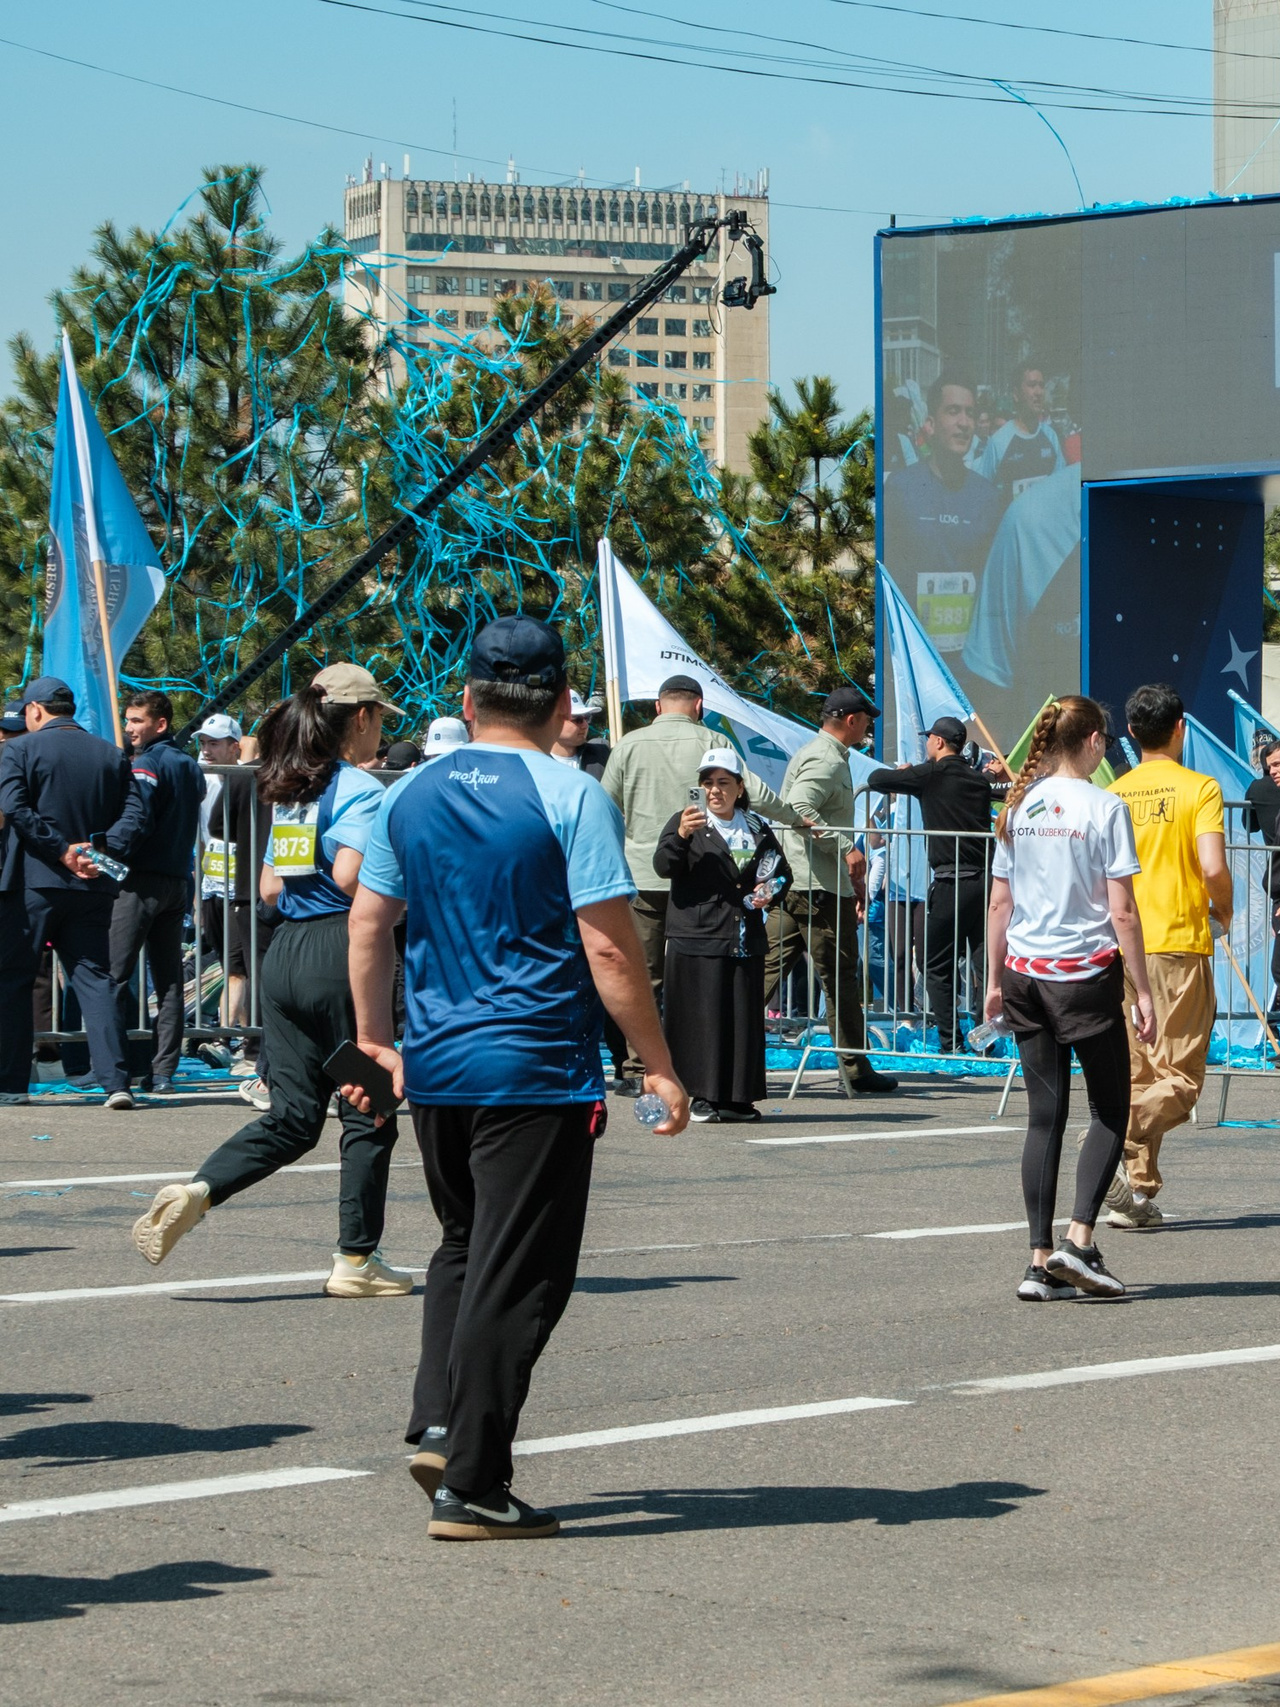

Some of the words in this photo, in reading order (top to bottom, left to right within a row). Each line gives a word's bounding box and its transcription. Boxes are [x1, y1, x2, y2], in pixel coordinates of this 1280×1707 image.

[448, 770, 469, 781] PRO
[477, 774, 500, 785] RUN
[1121, 786, 1176, 799] KAPITALBANK
[1037, 827, 1086, 841] UZBEKISTAN
[210, 859, 236, 873] 552
